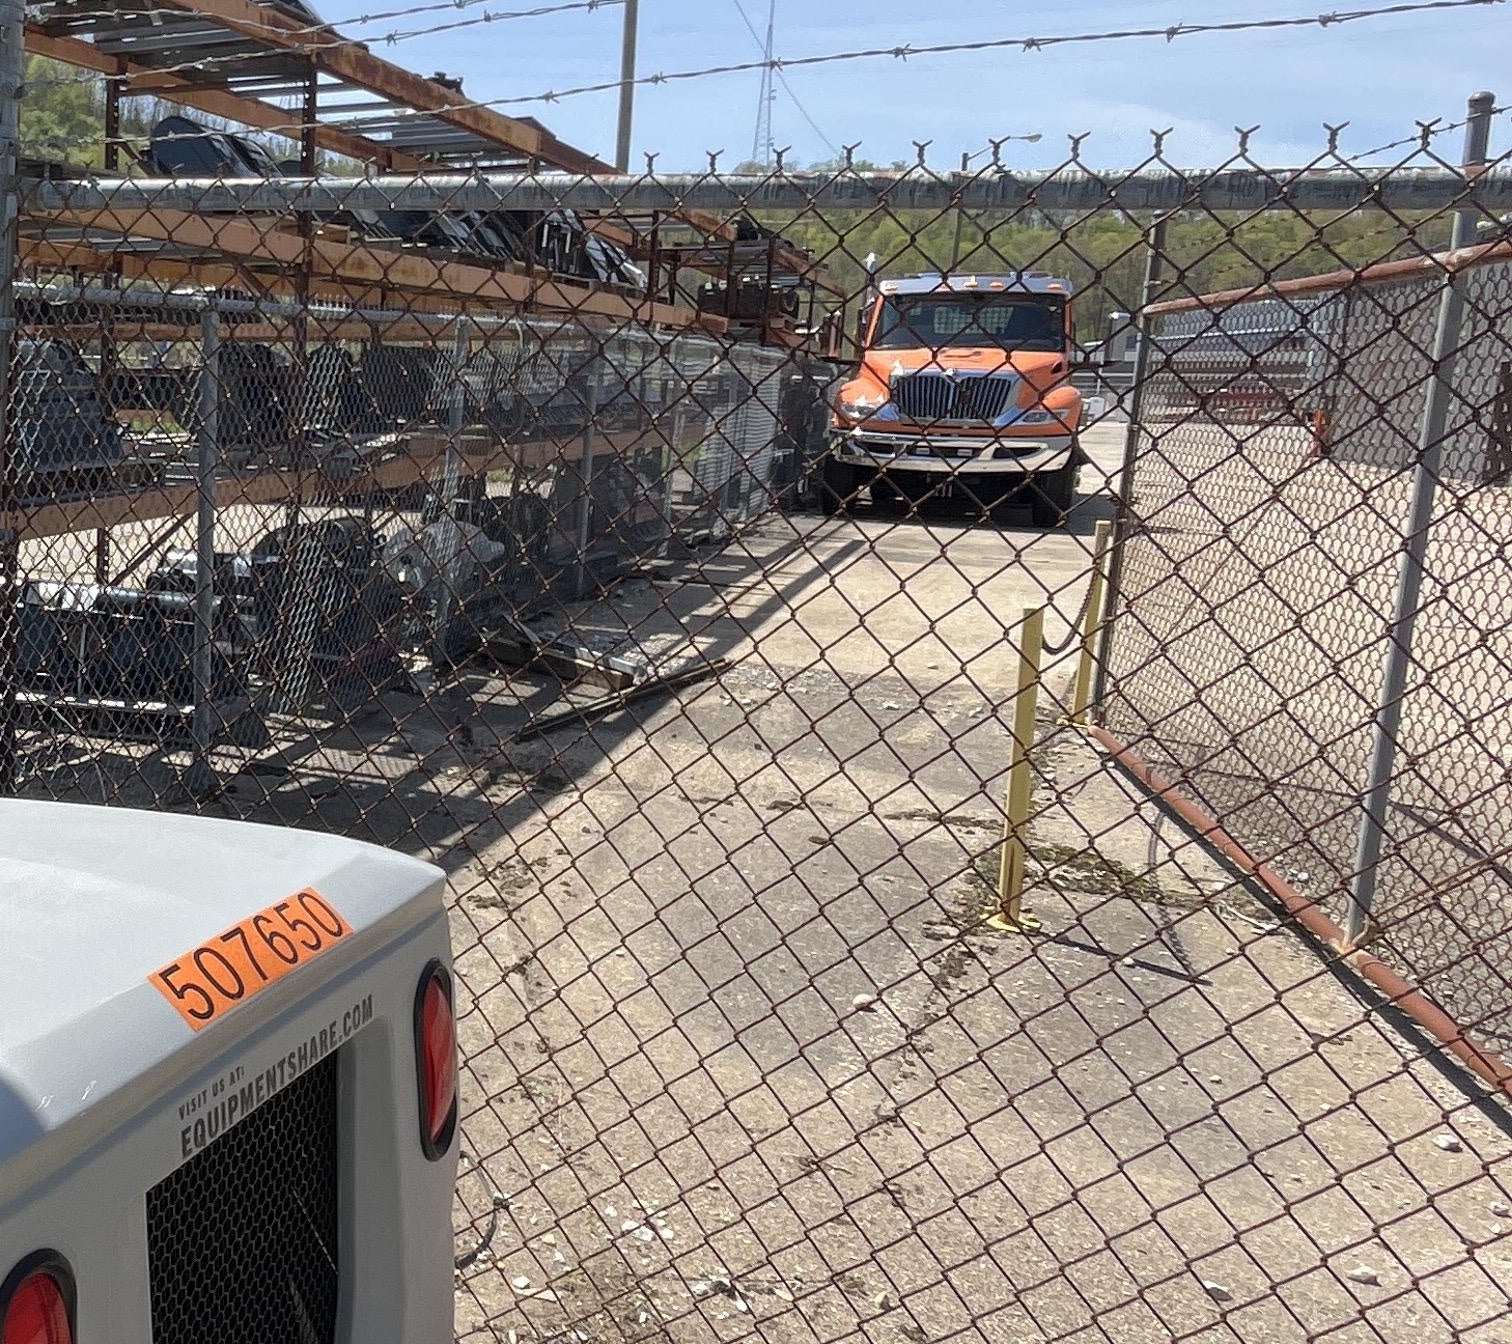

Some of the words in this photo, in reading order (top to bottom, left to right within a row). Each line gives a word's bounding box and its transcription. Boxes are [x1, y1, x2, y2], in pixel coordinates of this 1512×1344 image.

[158, 892, 344, 1020] 507650
[177, 1089, 208, 1121] VISIT
[212, 1077, 226, 1098] US
[180, 993, 374, 1158] EQUIPMENTSHARE.COM
